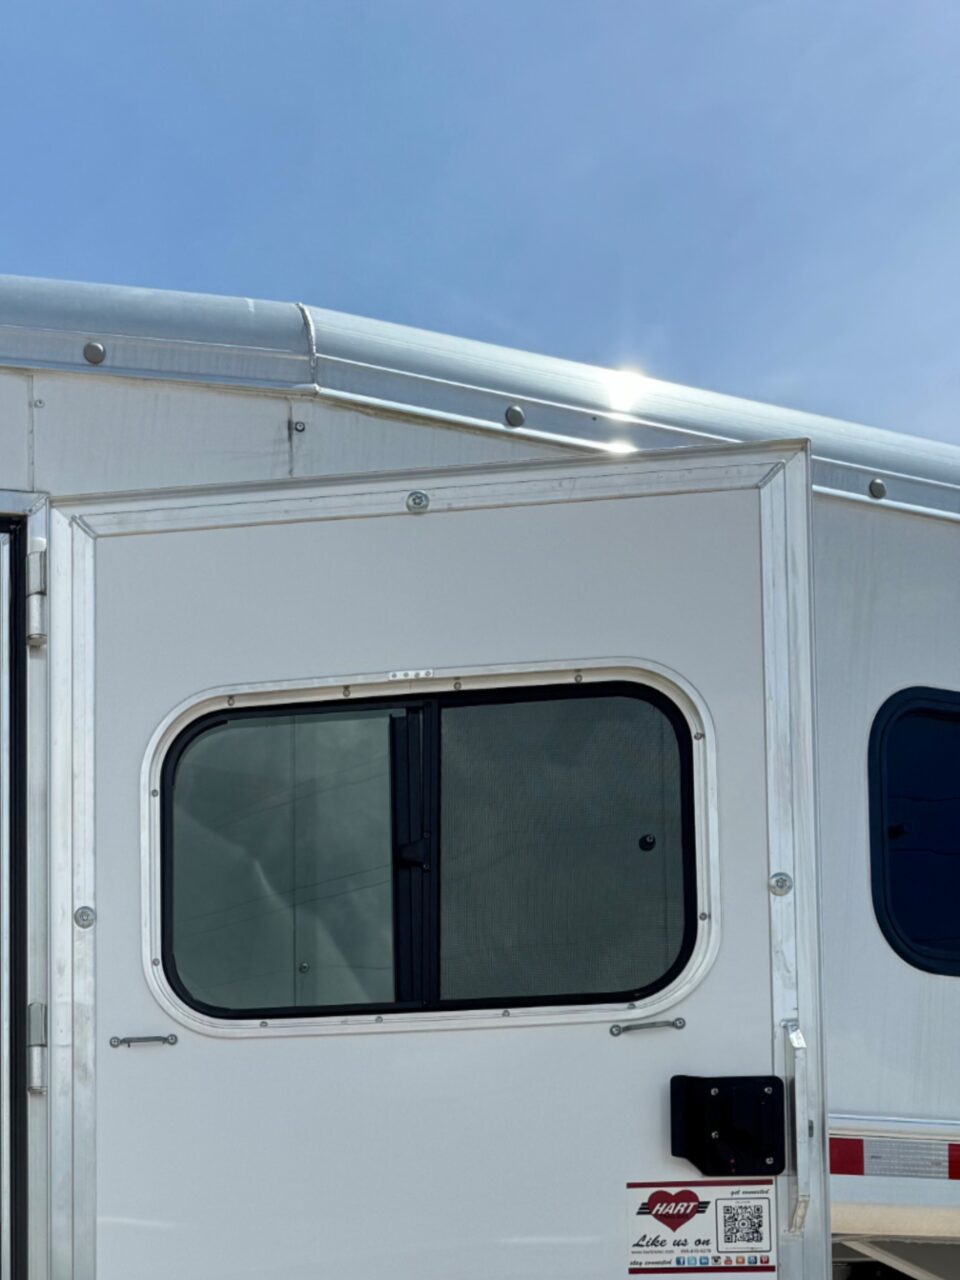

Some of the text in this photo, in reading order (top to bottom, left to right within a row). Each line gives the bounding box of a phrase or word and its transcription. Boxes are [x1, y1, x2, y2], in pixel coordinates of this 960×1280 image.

[651, 1201, 698, 1215] HART
[632, 1234, 711, 1248] Like us on
